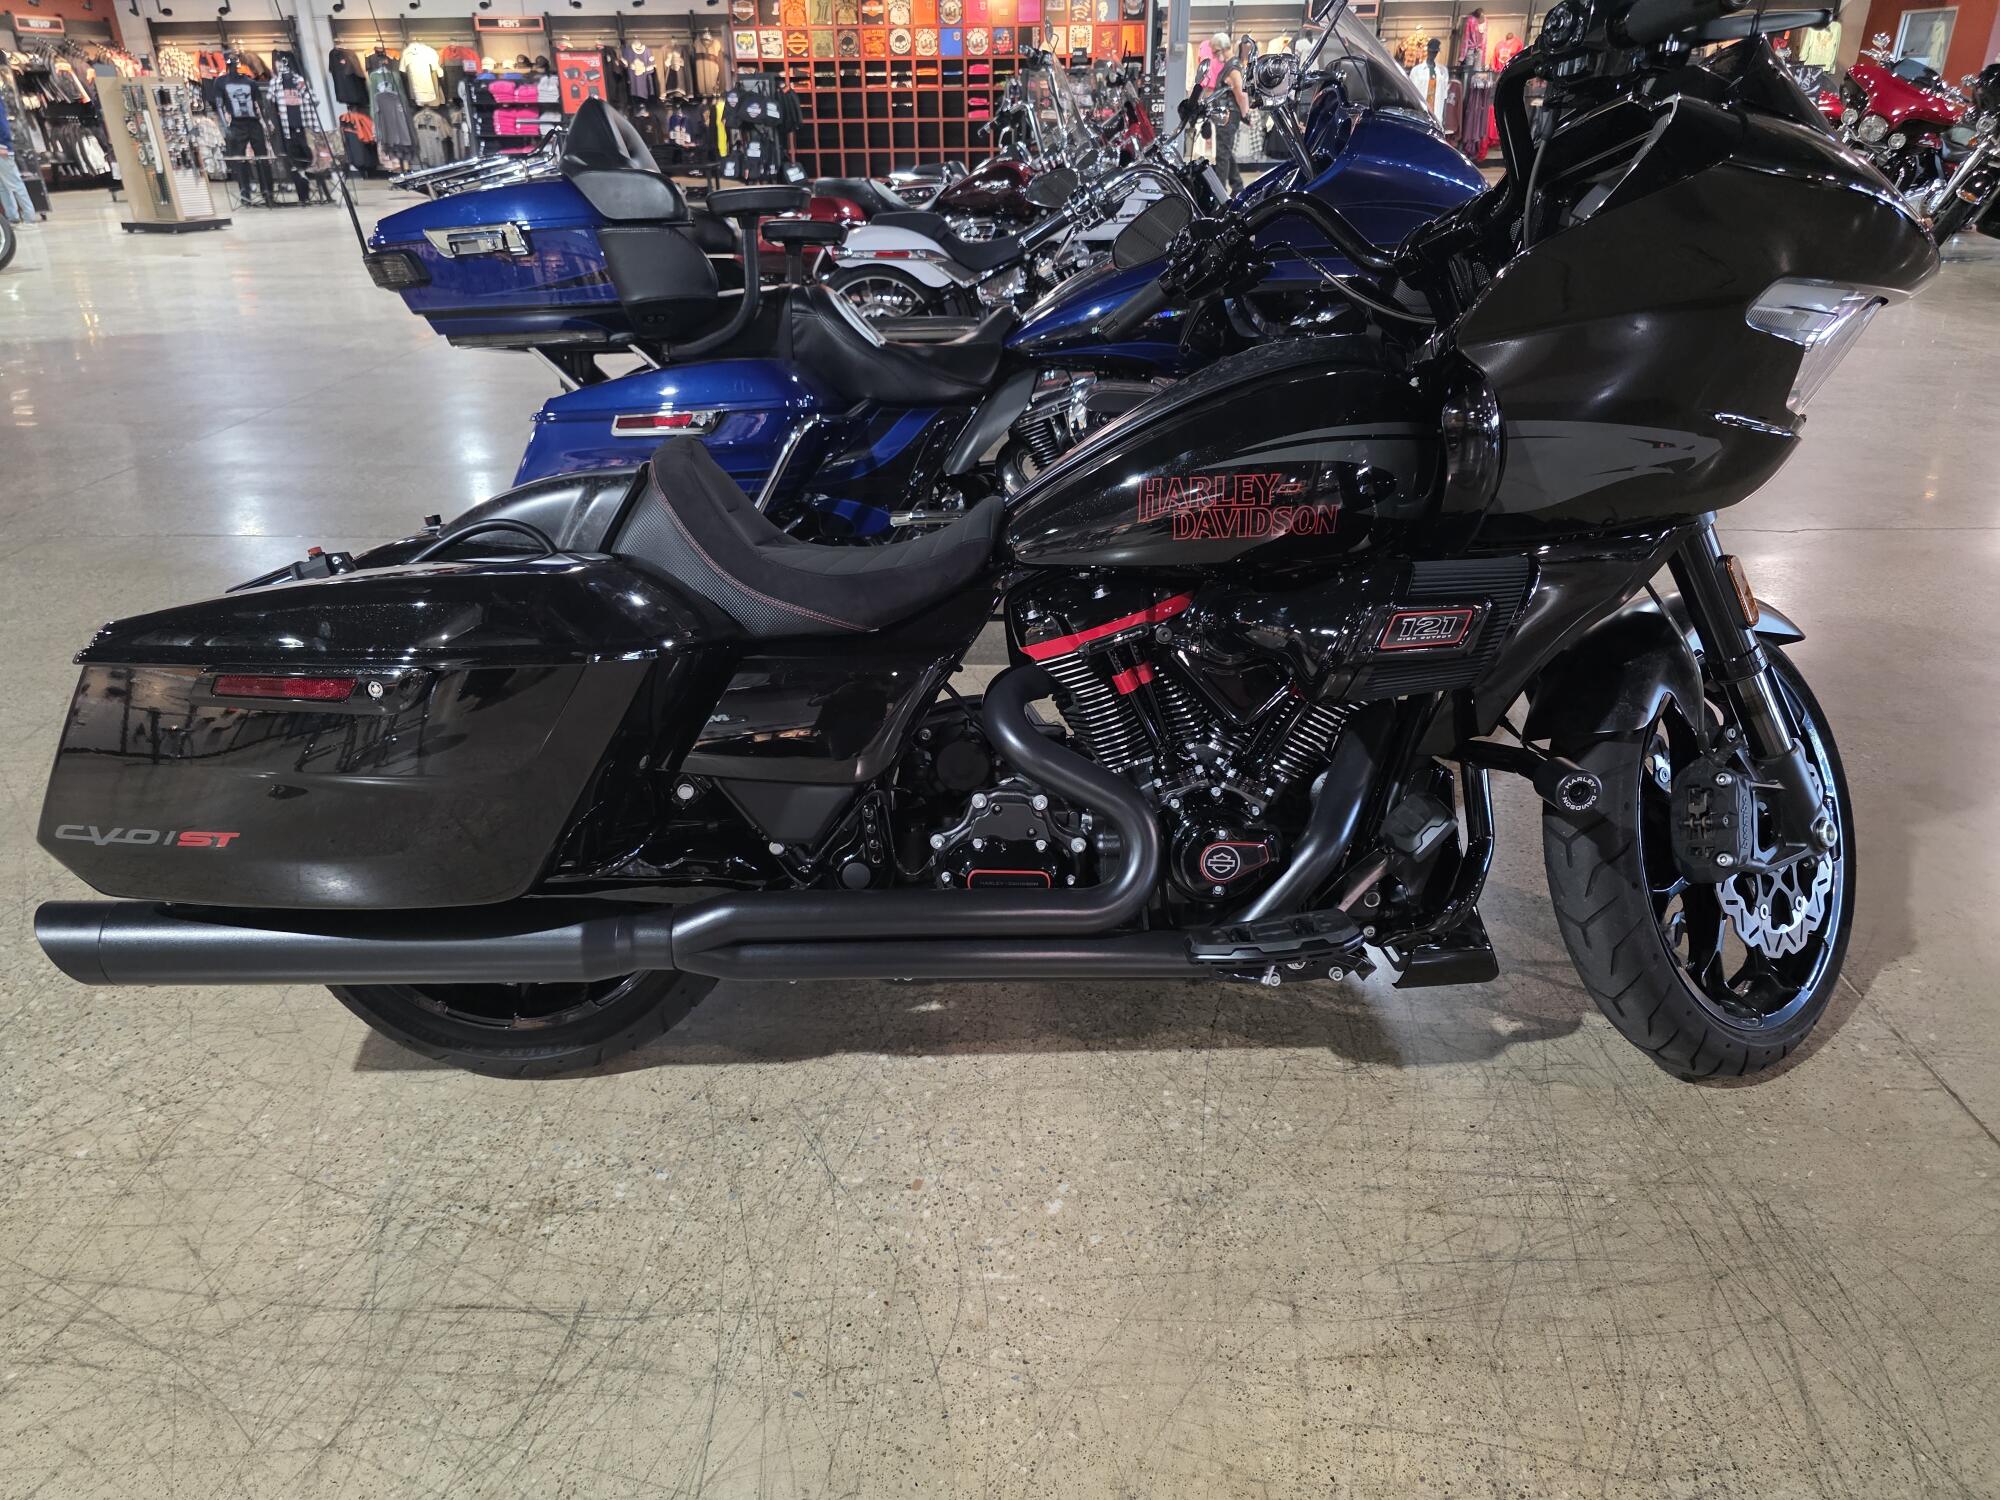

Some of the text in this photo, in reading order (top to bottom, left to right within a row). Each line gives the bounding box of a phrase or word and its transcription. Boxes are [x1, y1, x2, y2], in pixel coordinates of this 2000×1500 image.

[1172, 505, 1340, 541] DAVIDSON
[1400, 616, 1458, 637] 121
[55, 824, 241, 848] CVO ST
